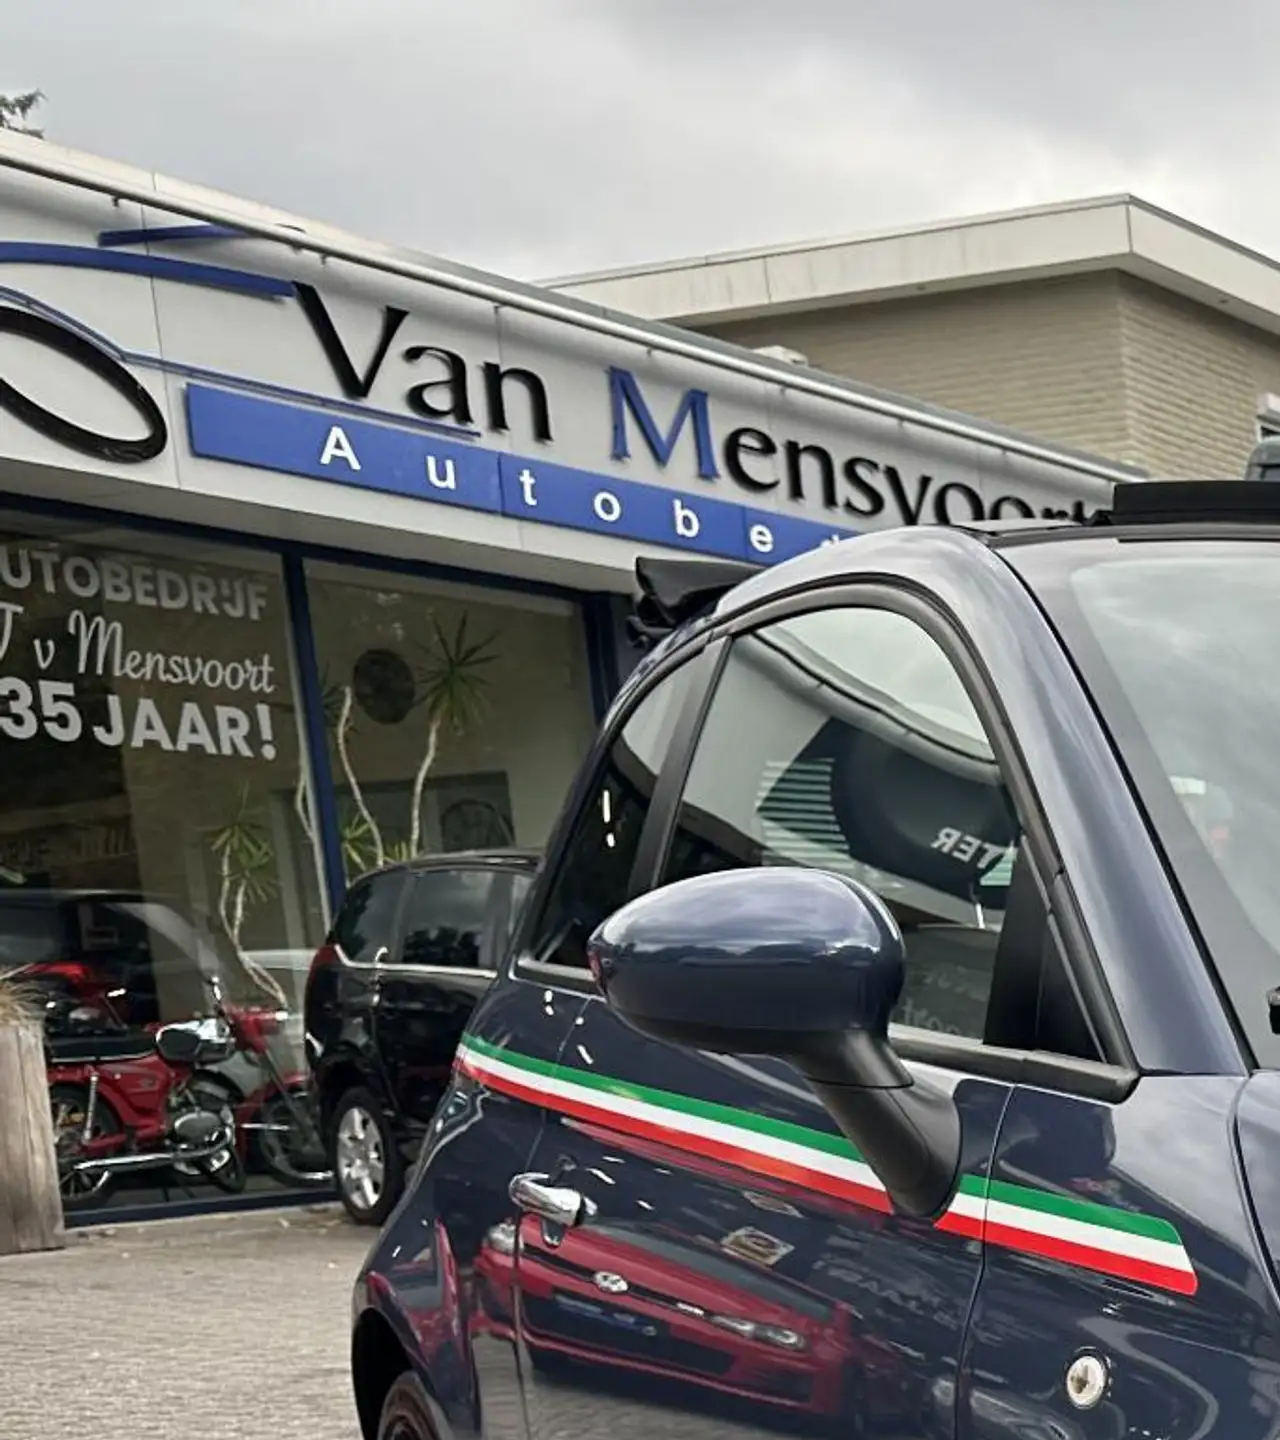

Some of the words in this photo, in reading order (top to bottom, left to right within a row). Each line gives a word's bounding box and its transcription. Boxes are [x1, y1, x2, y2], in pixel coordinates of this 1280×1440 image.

[291, 280, 554, 443] Van
[606, 364, 1085, 525] Mensvo
[319, 426, 840, 553] Autobe
[0, 547, 269, 620] UTOBEDRIJF
[34, 638, 55, 669] v
[68, 609, 276, 693] Mensvoort
[0, 676, 83, 742] 35
[92, 694, 276, 760] JAAR!
